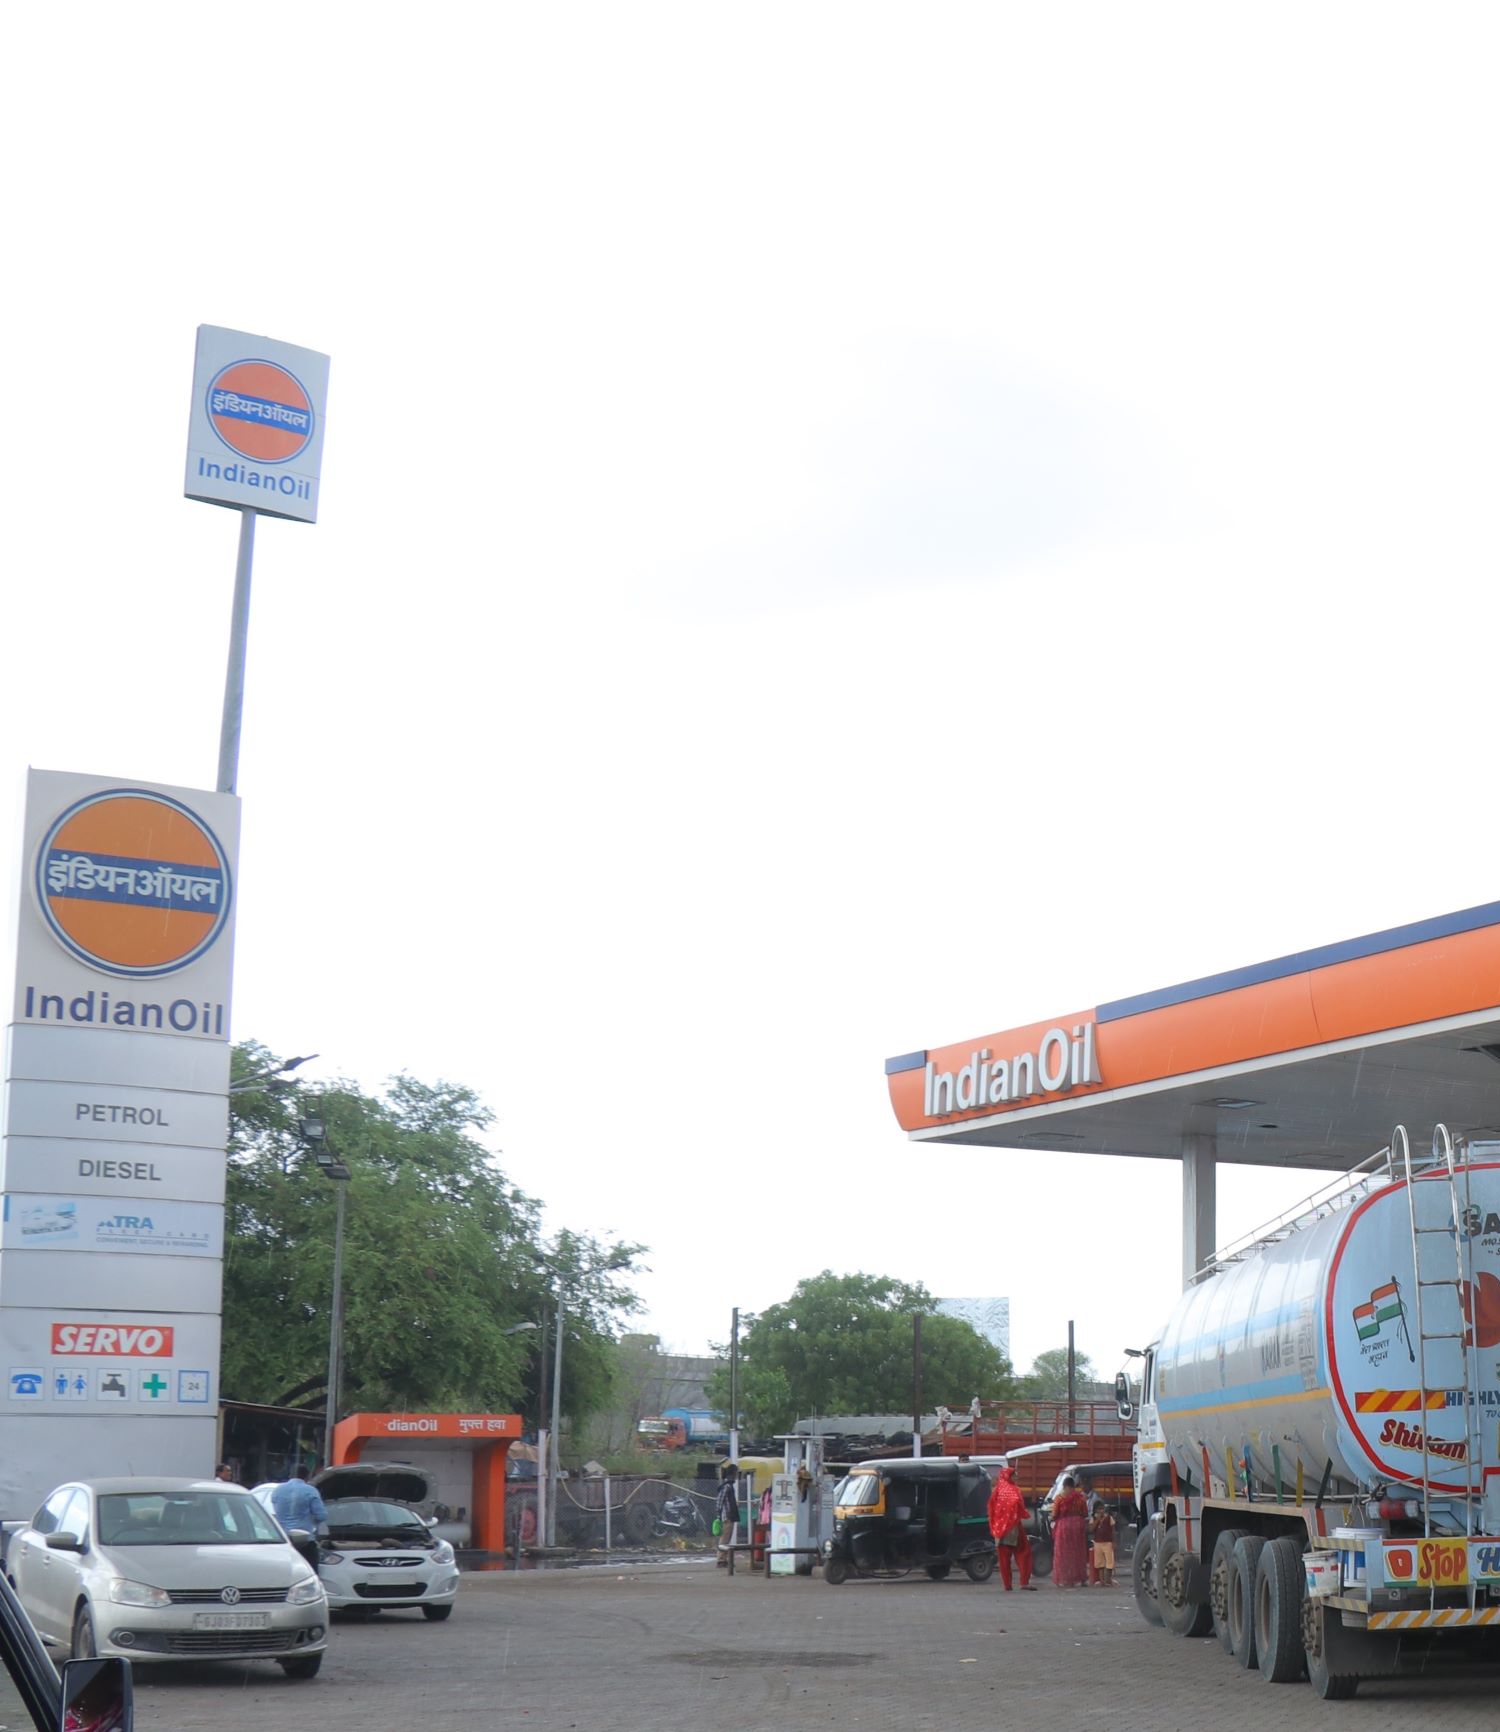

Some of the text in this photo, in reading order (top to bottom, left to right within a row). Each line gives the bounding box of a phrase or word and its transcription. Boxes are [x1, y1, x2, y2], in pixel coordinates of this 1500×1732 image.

[213, 391, 309, 429] इंडियनऑयल
[198, 456, 310, 501] IndianOil
[47, 853, 220, 904] इंडियनऑयल
[24, 985, 223, 1035] IndianOil
[923, 1022, 1102, 1117] IndianOil
[76, 1103, 169, 1127] PETROL
[78, 1159, 162, 1181] DIESEL
[54, 1326, 164, 1355] SERVO
[188, 1381, 200, 1391] 24
[487, 1419, 506, 1432] हवा
[1419, 1543, 1467, 1581] Stop
